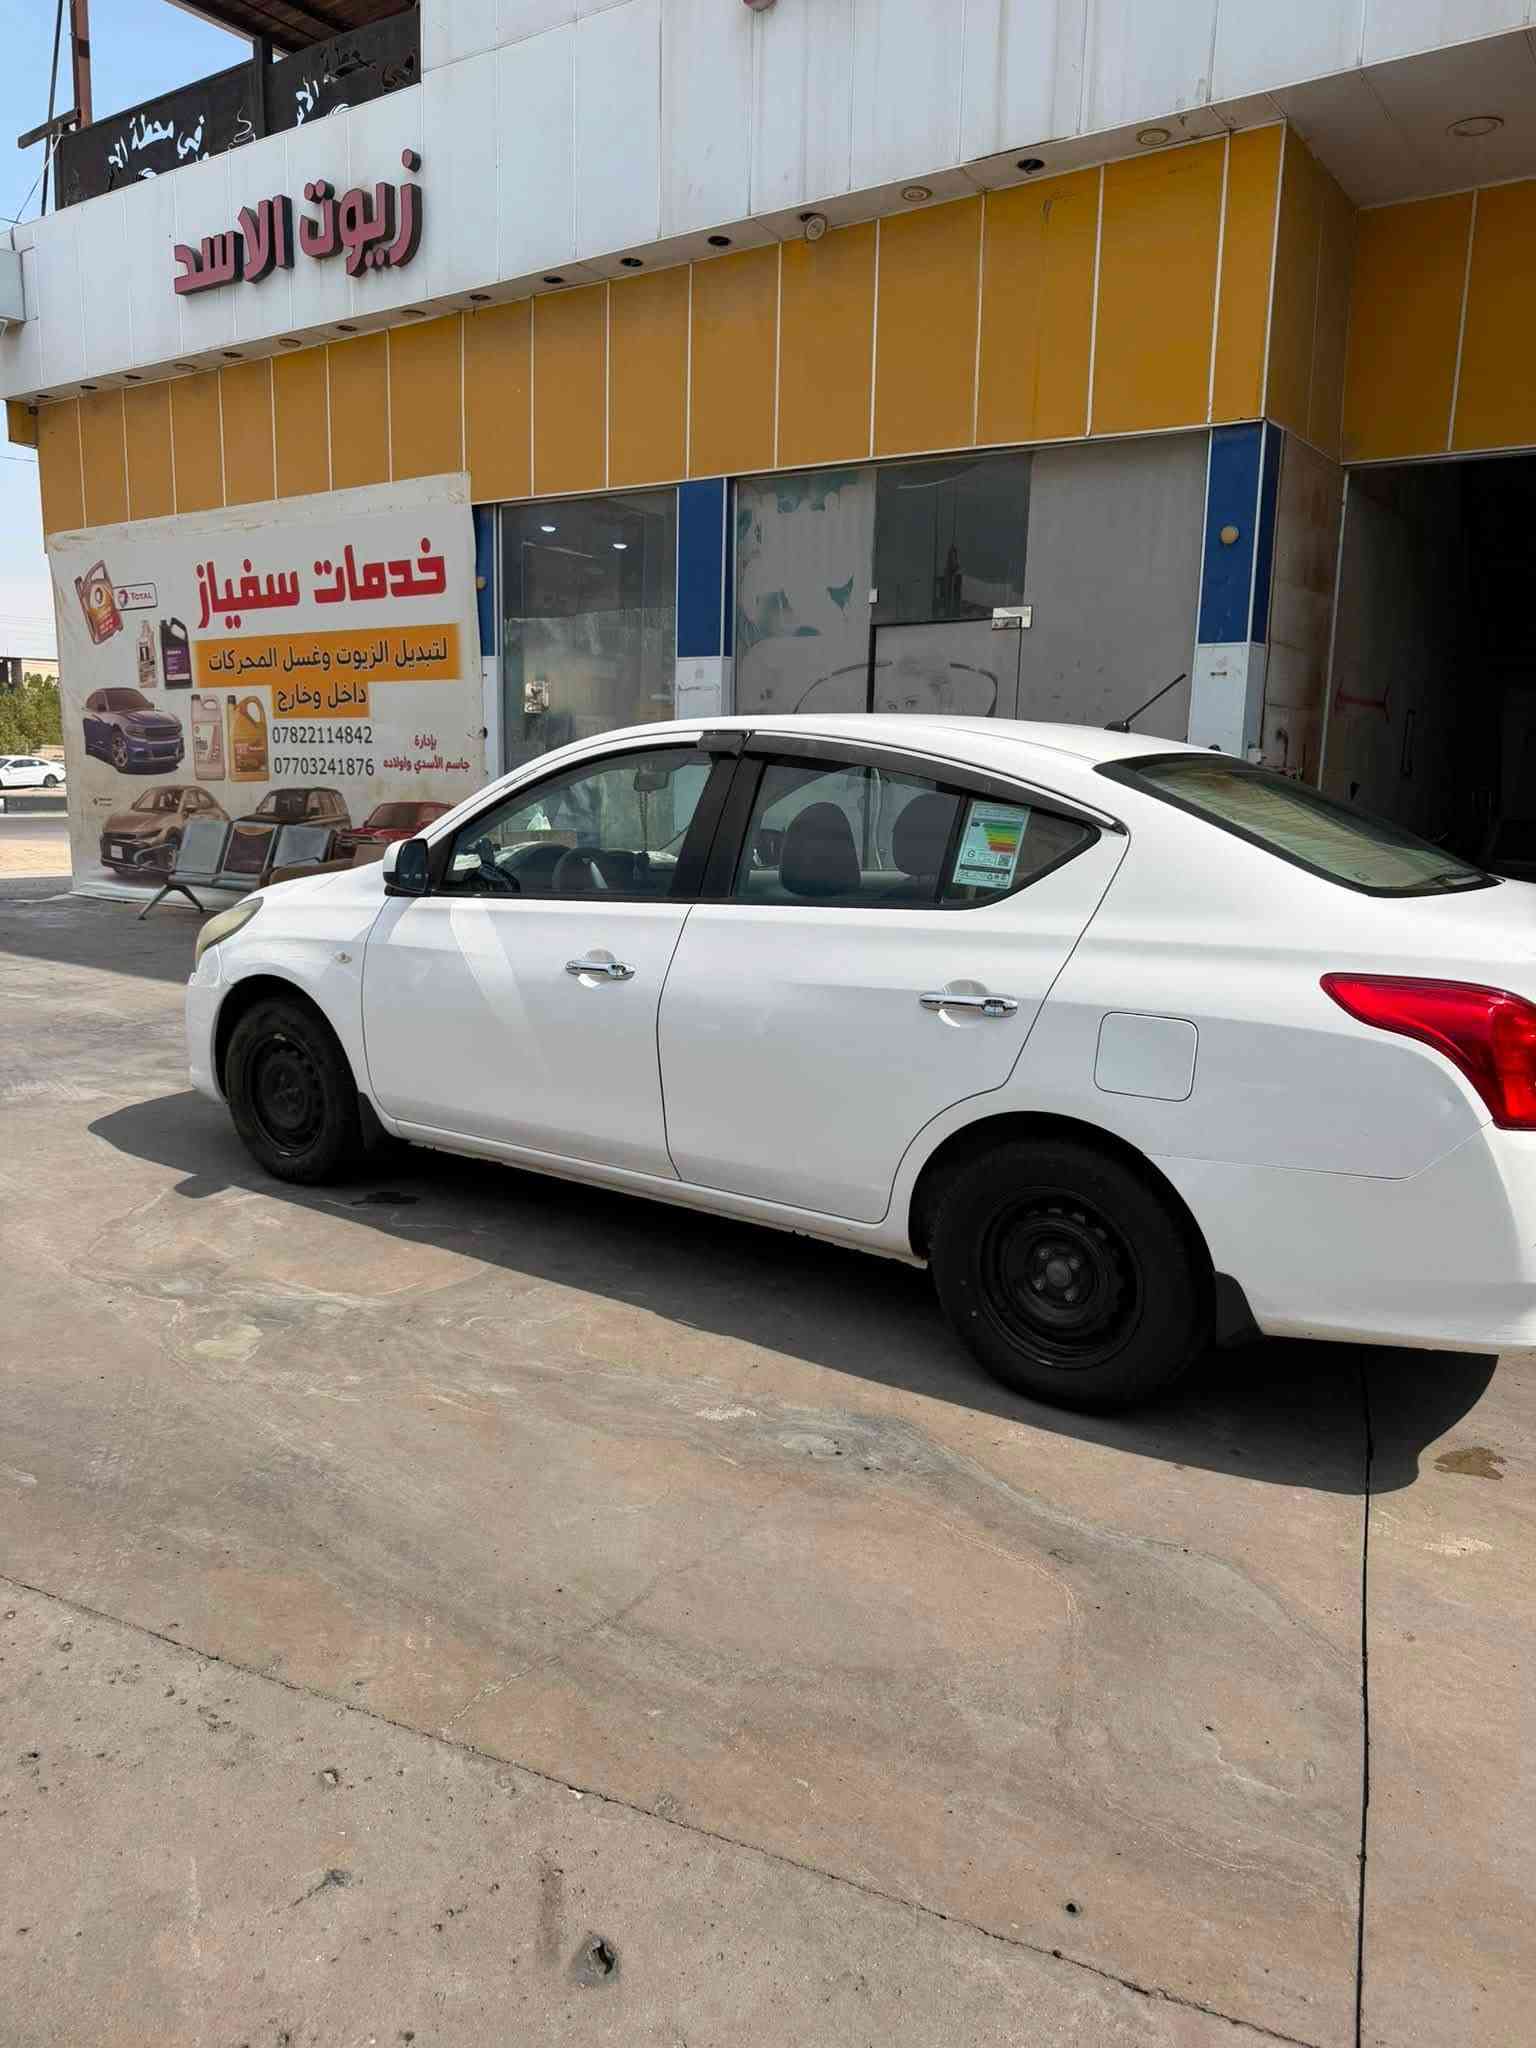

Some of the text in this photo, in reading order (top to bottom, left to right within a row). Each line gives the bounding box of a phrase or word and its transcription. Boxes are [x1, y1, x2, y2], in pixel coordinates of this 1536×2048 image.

[129, 113, 175, 150] محطة
[177, 114, 205, 159] في
[174, 148, 422, 296] زيوت الاسد
[130, 590, 153, 602] TOTAL
[196, 537, 447, 630] خدمات سفياز
[208, 647, 278, 675] المحركات
[283, 645, 331, 672] وغسل
[336, 640, 389, 670] الزيوت
[395, 637, 448, 668] لتبديل
[277, 682, 367, 713] داخل وخارج
[272, 725, 373, 744] 07822114842
[273, 756, 375, 777] 07703241876
[445, 757, 470, 773] جاسم
